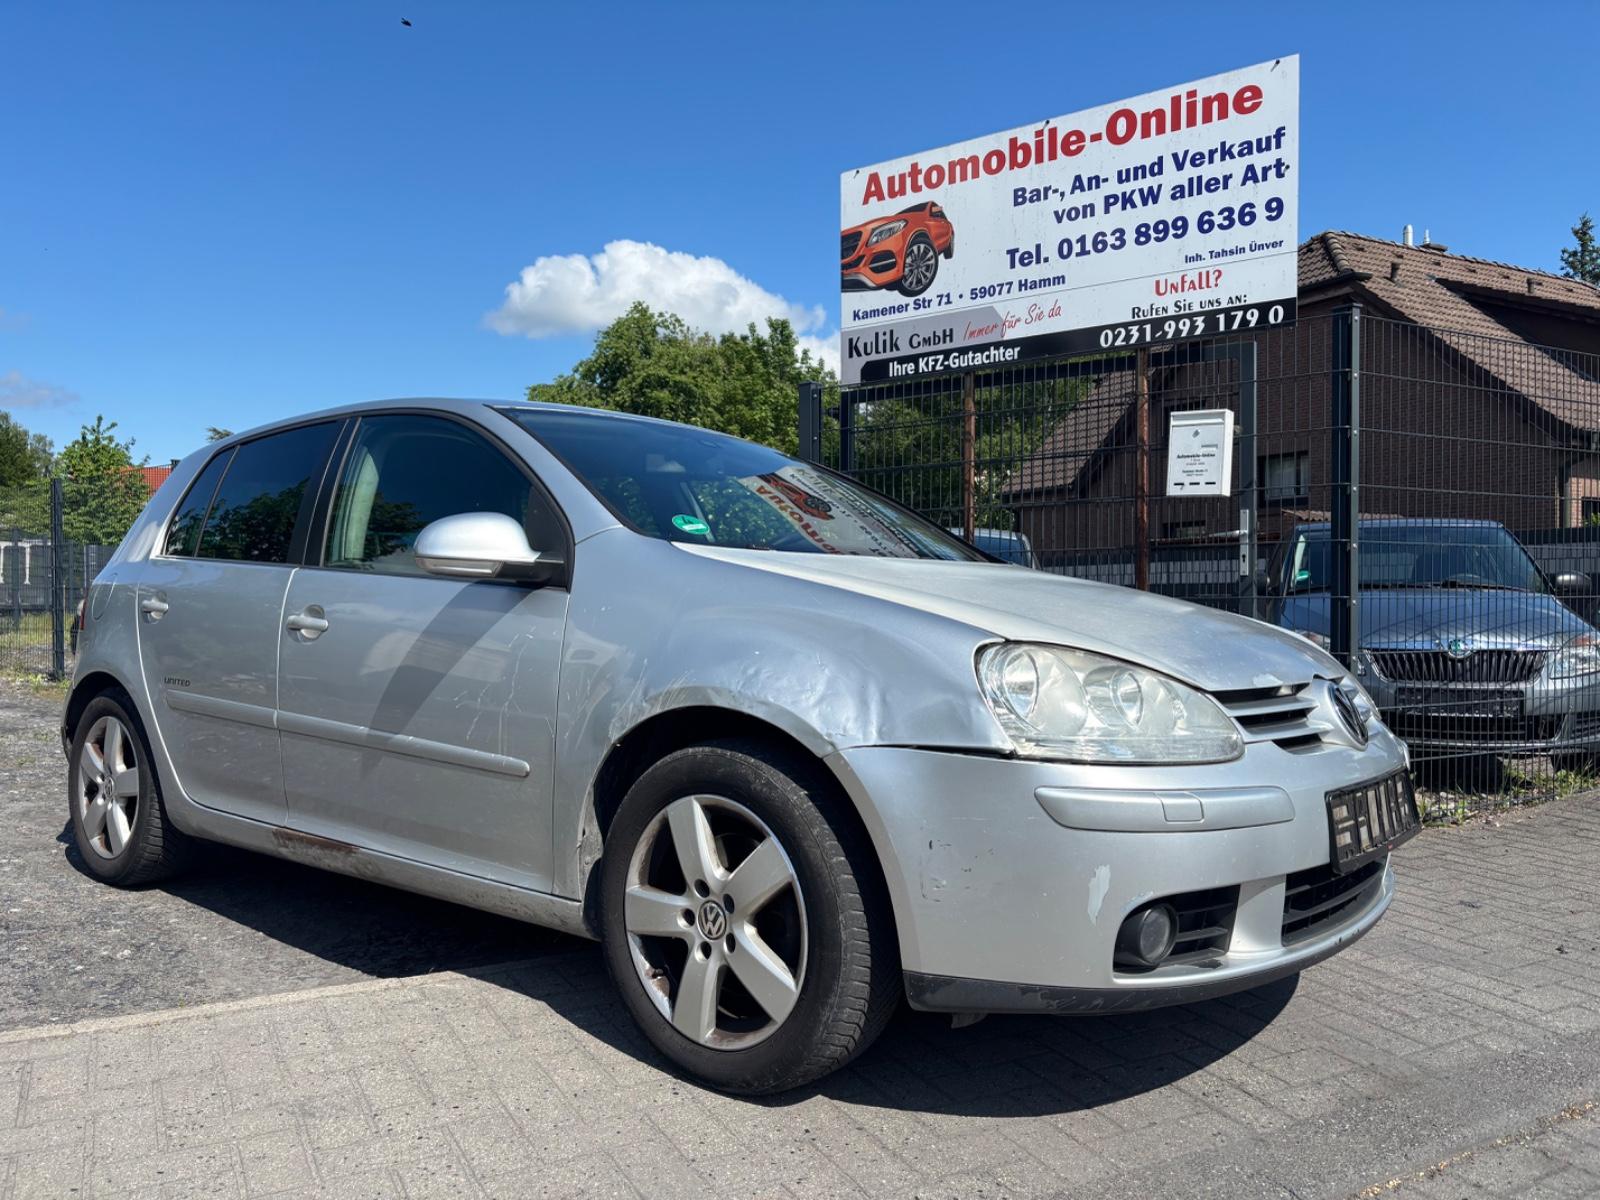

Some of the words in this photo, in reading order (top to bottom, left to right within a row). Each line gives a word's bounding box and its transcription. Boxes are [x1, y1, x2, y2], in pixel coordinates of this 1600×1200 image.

[862, 84, 1264, 205] Automobile-Online
[1013, 185, 1066, 207] Bar-,
[1070, 174, 1109, 195] An-
[1117, 155, 1164, 185] und
[1171, 126, 1286, 172] Verkauf
[1053, 203, 1096, 225] von
[1103, 184, 1163, 215] PKW
[1170, 173, 1233, 201] aller
[1240, 157, 1286, 187] Art
[1006, 242, 1049, 270] Tel.
[1057, 227, 1127, 260] 0163
[1134, 215, 1189, 246] 899
[1196, 202, 1257, 234] 636
[1264, 196, 1285, 222] 9
[1184, 253, 1206, 264] Inh.
[1208, 245, 1246, 260] Tahsin
[1249, 240, 1284, 253] Ünver
[852, 304, 910, 321] Kamener
[912, 297, 933, 311] Str
[936, 292, 953, 307] 71
[969, 281, 1014, 300] 59077
[1017, 274, 1066, 292] Hamm
[962, 320, 999, 342] Immer
[1000, 310, 1021, 339] für
[1024, 302, 1045, 325] Sie
[1047, 299, 1062, 318] da
[1099, 315, 1206, 349] 0231-993
[1215, 308, 1260, 332] 179
[848, 328, 901, 360] Kulik
[888, 360, 915, 378] Ihre
[918, 344, 1021, 374] KFZ-Gutachter
